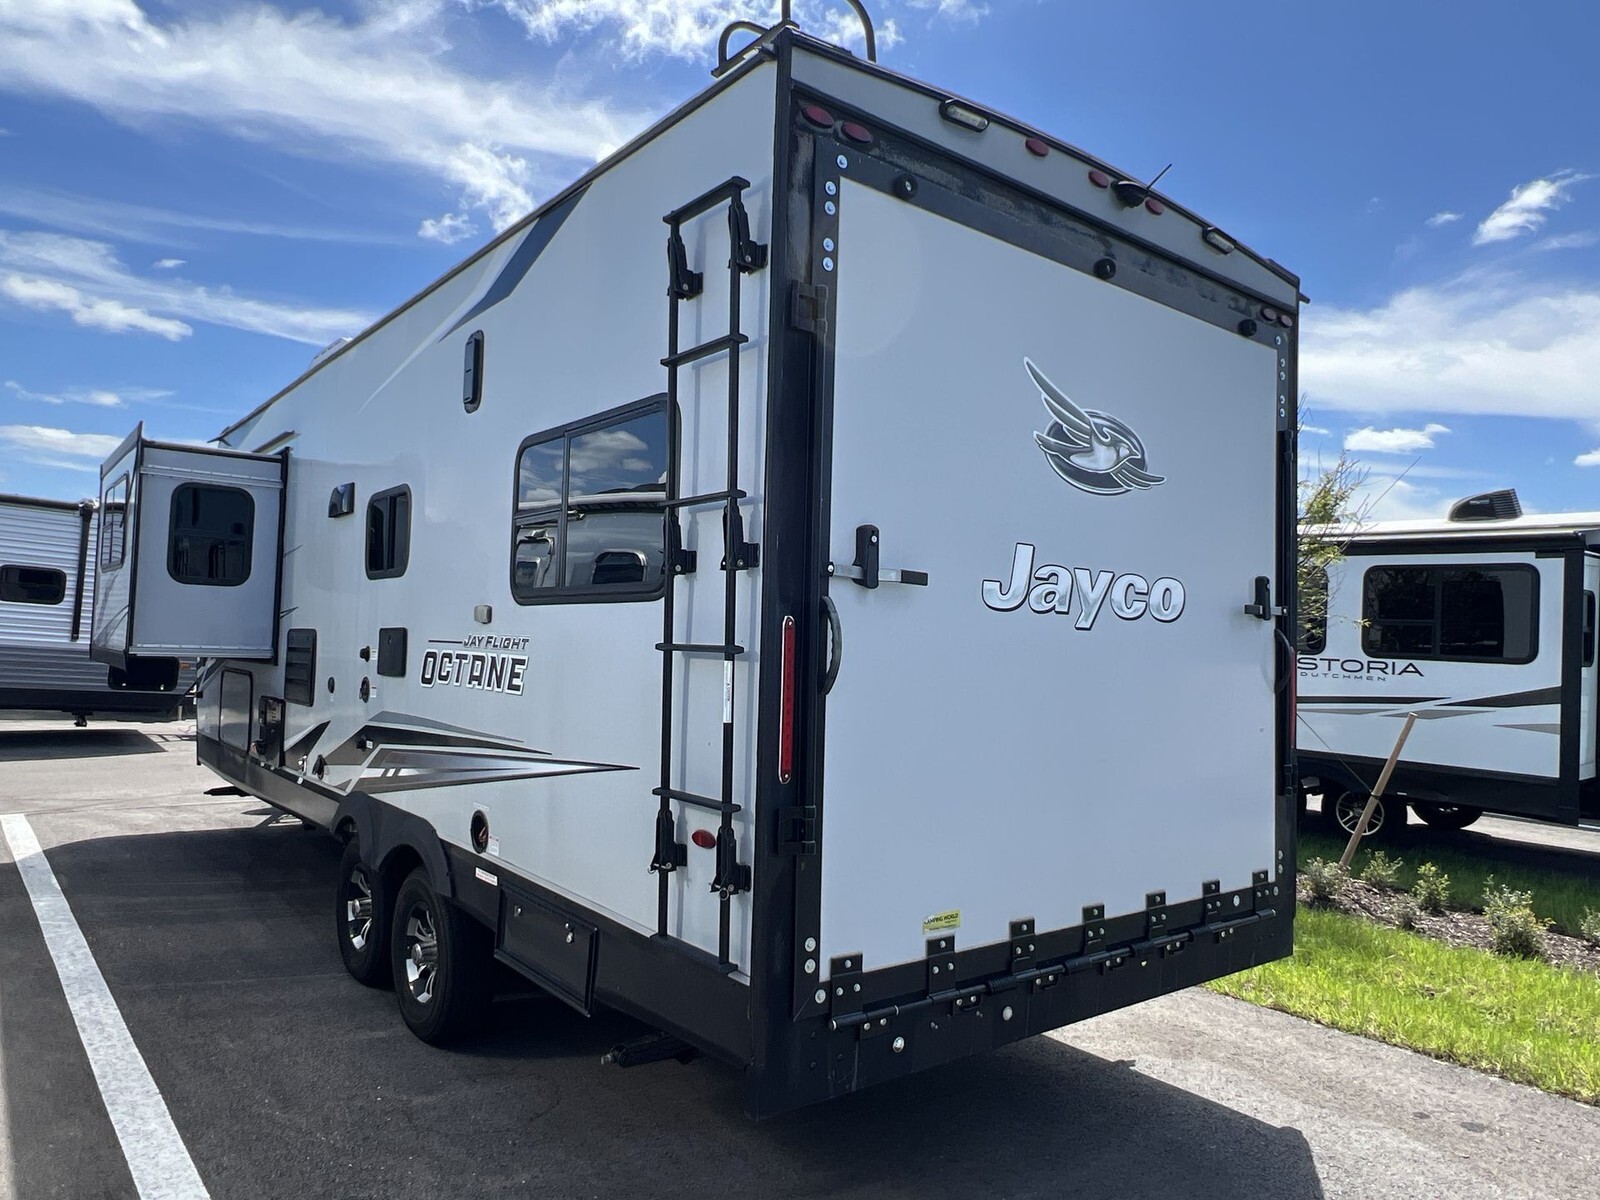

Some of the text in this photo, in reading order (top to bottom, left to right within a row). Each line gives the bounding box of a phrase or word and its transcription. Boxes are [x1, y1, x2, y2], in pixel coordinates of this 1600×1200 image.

[982, 542, 1186, 631] Jayco
[463, 635, 530, 650] JAY FLIGHT
[420, 650, 529, 695] OCTANE
[1300, 671, 1386, 682] DUTCHMEN
